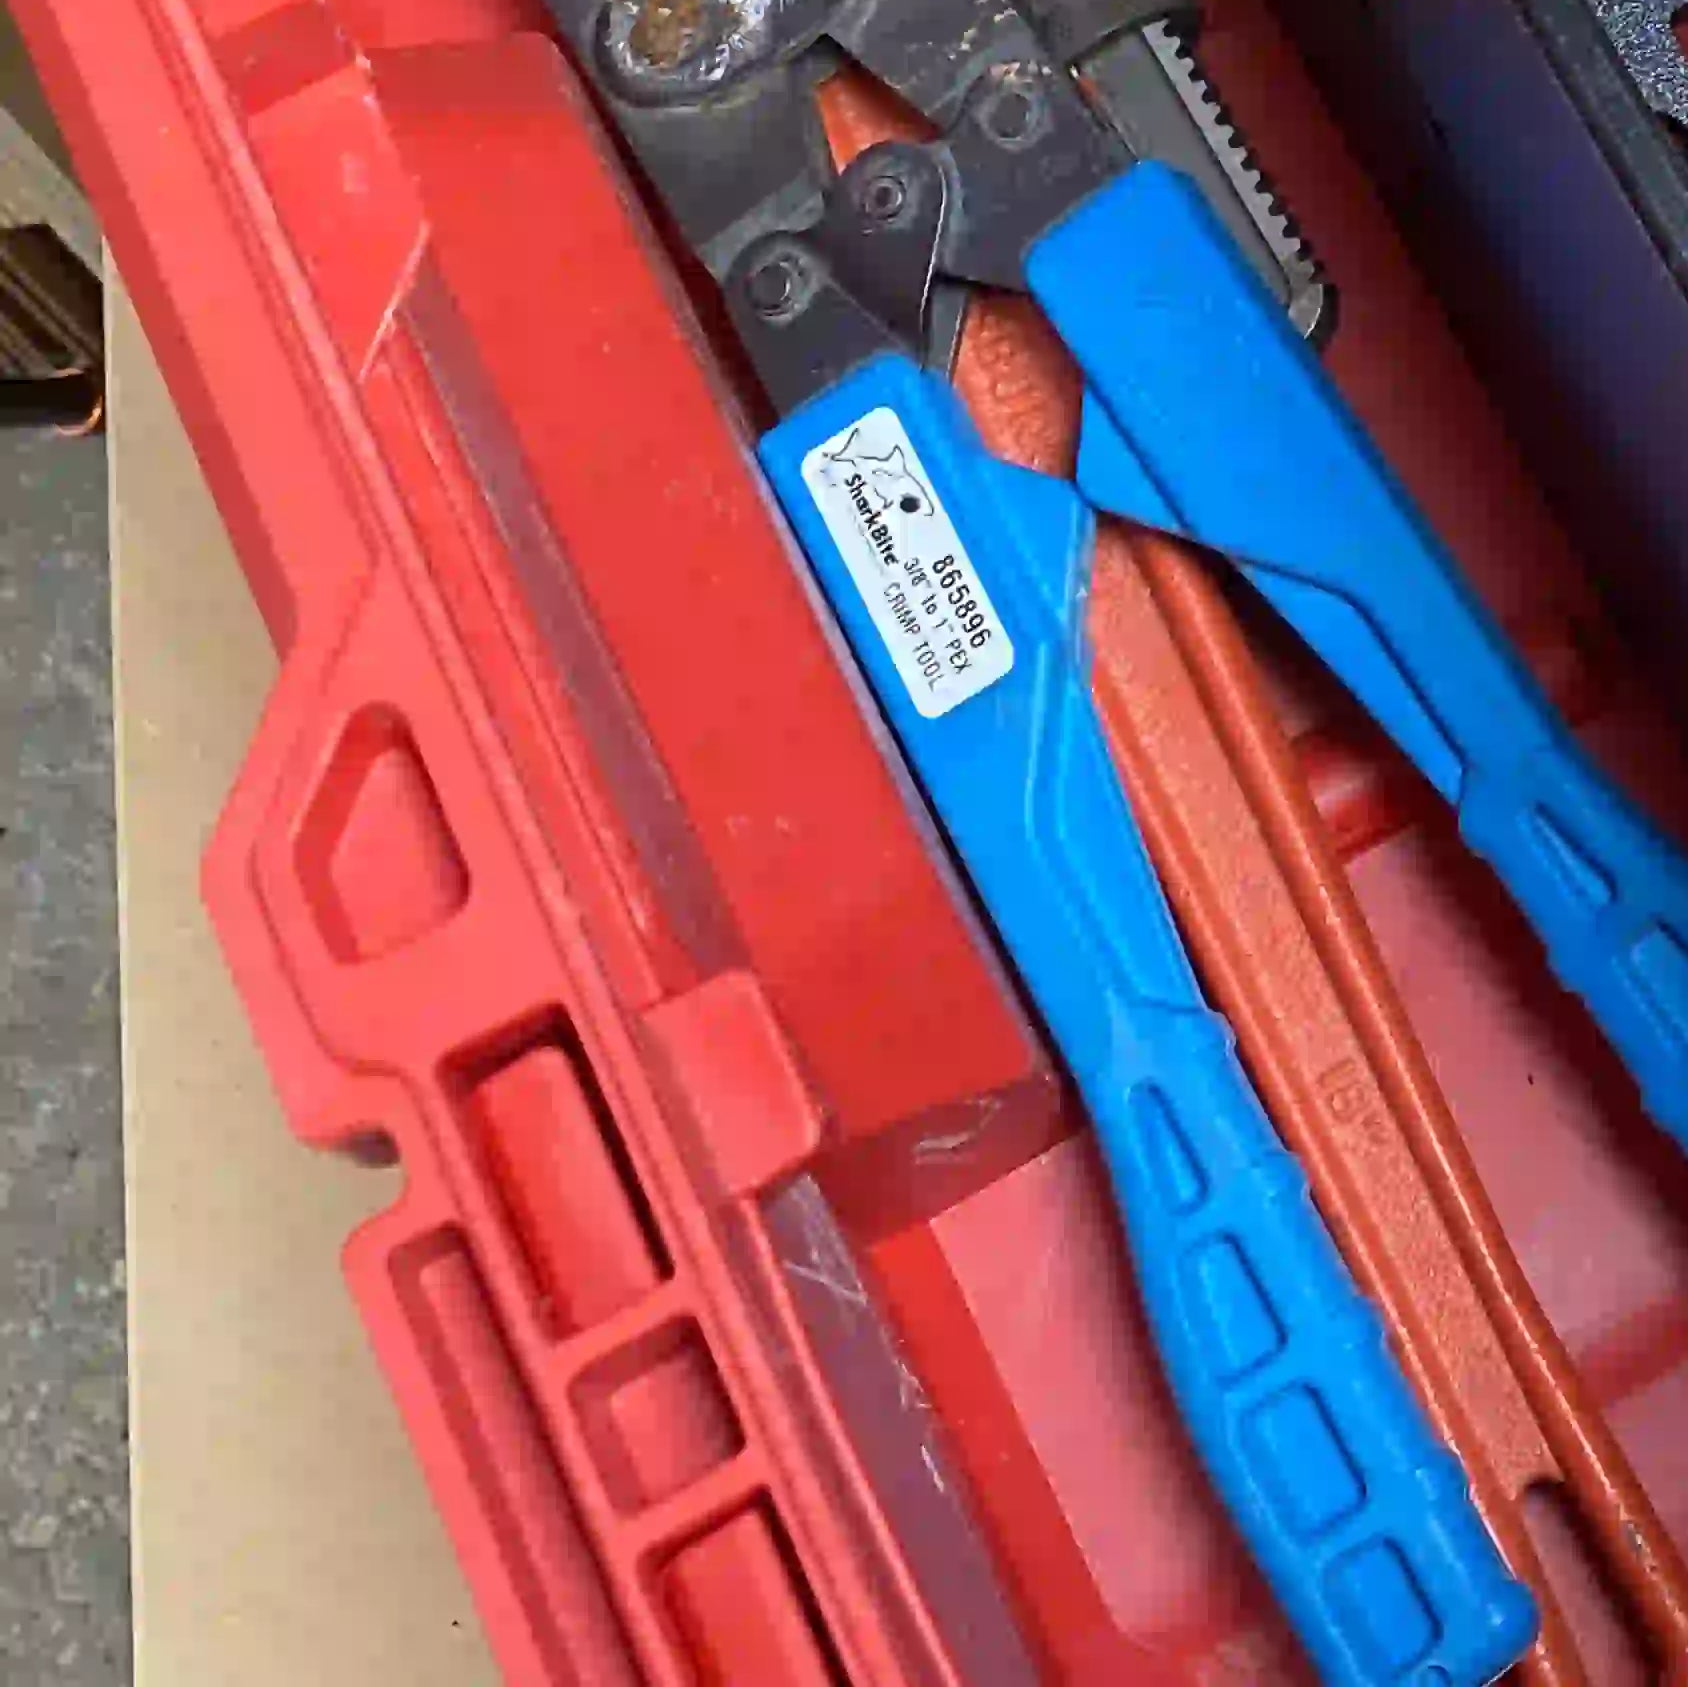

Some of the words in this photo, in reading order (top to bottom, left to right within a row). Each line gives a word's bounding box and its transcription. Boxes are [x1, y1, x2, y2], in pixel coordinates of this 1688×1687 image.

[845, 473, 899, 566] SharkBite
[884, 581, 922, 635] CRIMP
[913, 640, 945, 692] TOOL
[921, 593, 938, 615] to
[945, 638, 972, 674] PEX
[932, 554, 992, 649] 865896
